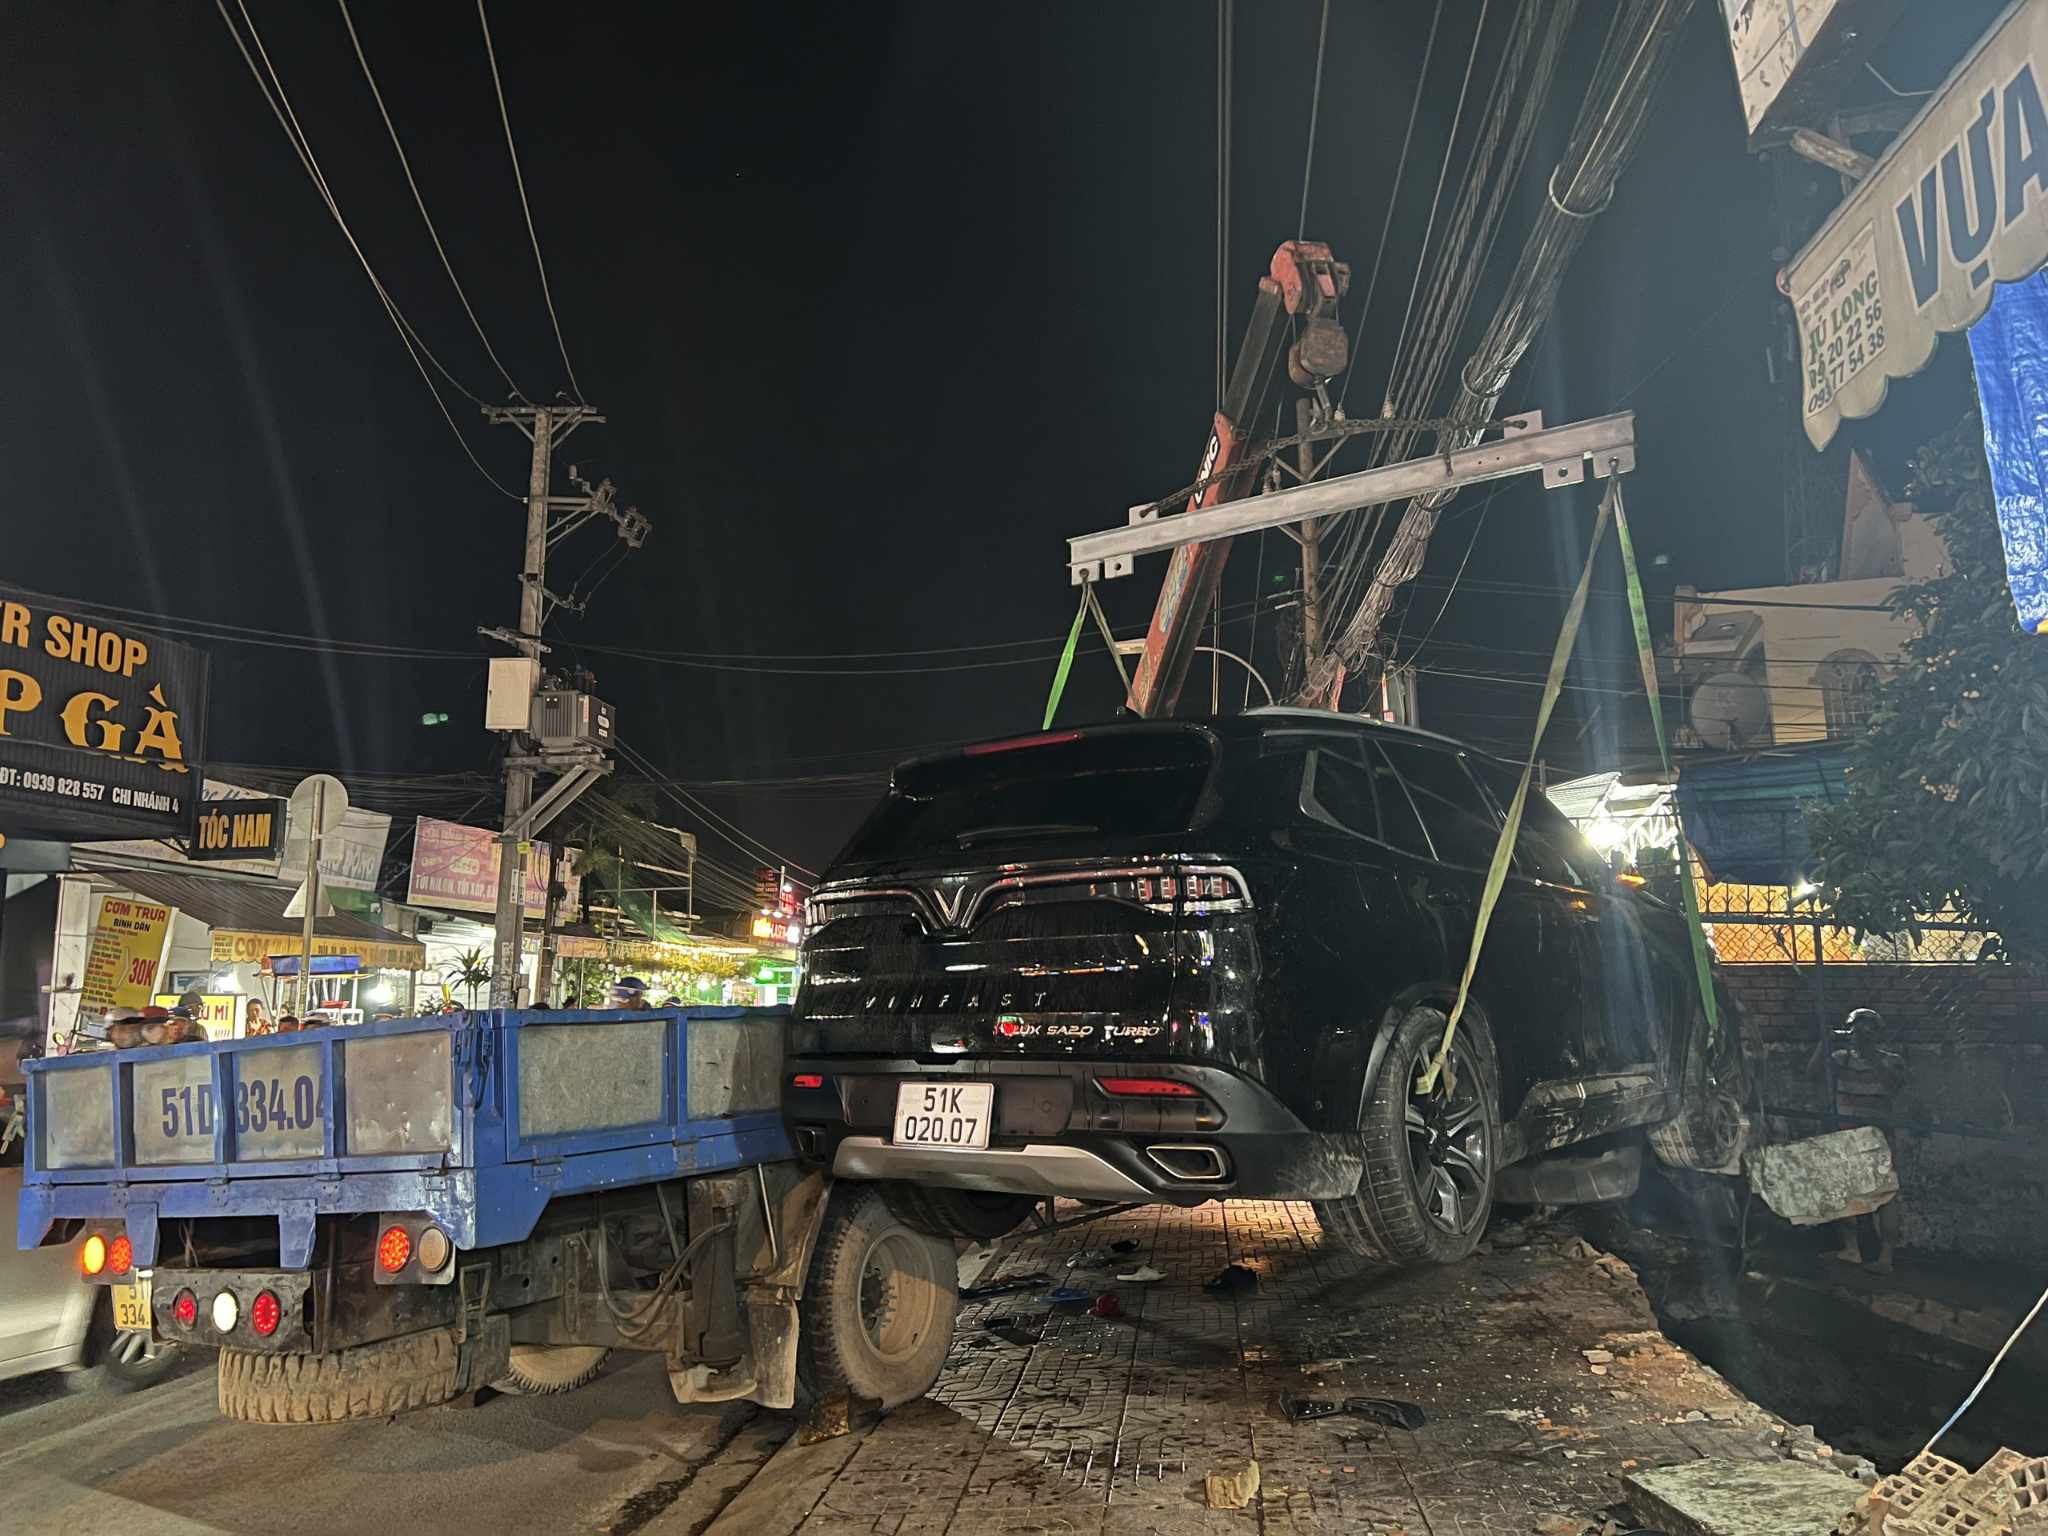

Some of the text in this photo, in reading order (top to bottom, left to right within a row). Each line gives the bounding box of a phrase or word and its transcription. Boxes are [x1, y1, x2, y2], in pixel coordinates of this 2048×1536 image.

[1831, 270, 1879, 336] LONG
[1828, 336, 1843, 366] 20
[1847, 318, 1862, 348] 22
[1865, 299, 1882, 330] 56
[1849, 343, 1865, 374] 54
[1868, 326, 1885, 356] 38
[45, 615, 149, 678] SHOP
[60, 682, 190, 773] GÀ
[23, 771, 55, 792] 0939
[57, 778, 81, 797] 828
[82, 782, 105, 801] 557
[112, 787, 131, 805] CHI
[133, 791, 170, 812] NHÁNH
[172, 798, 180, 813] 4
[199, 808, 271, 849] TÓC NAM
[129, 957, 157, 987] 30K
[866, 991, 1047, 1009] VINFAST
[161, 1083, 214, 1138] 51D
[923, 1087, 963, 1113] 51K
[905, 1116, 978, 1144] 020.07
[120, 1303, 149, 1326] 334.
